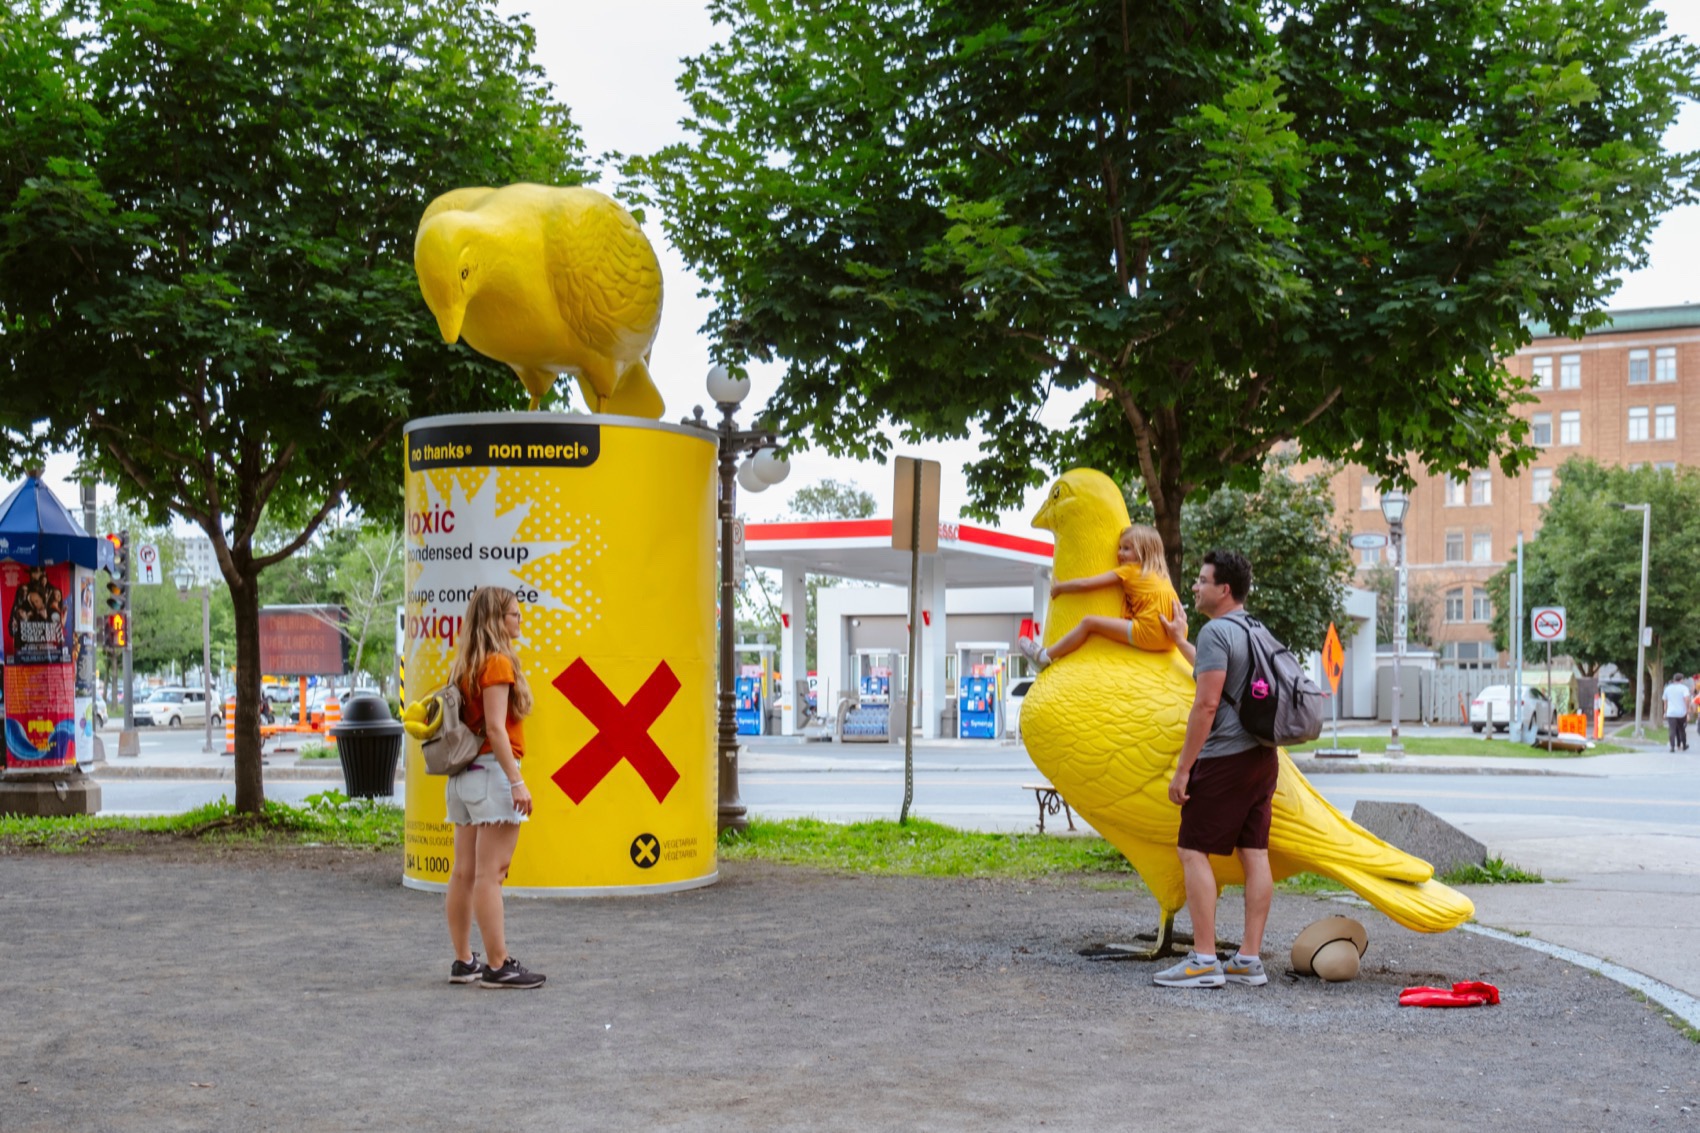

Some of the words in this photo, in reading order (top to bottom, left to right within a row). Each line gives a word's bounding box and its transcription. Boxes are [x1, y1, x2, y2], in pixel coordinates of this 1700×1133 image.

[411, 448, 422, 462] no
[488, 444, 522, 458] non
[408, 503, 455, 535] toxic
[407, 542, 473, 562] condensed
[479, 546, 529, 564] soup
[438, 585, 539, 603] condée
[408, 608, 463, 648] toxiq
[417, 855, 423, 871] L
[425, 856, 450, 873] 1000
